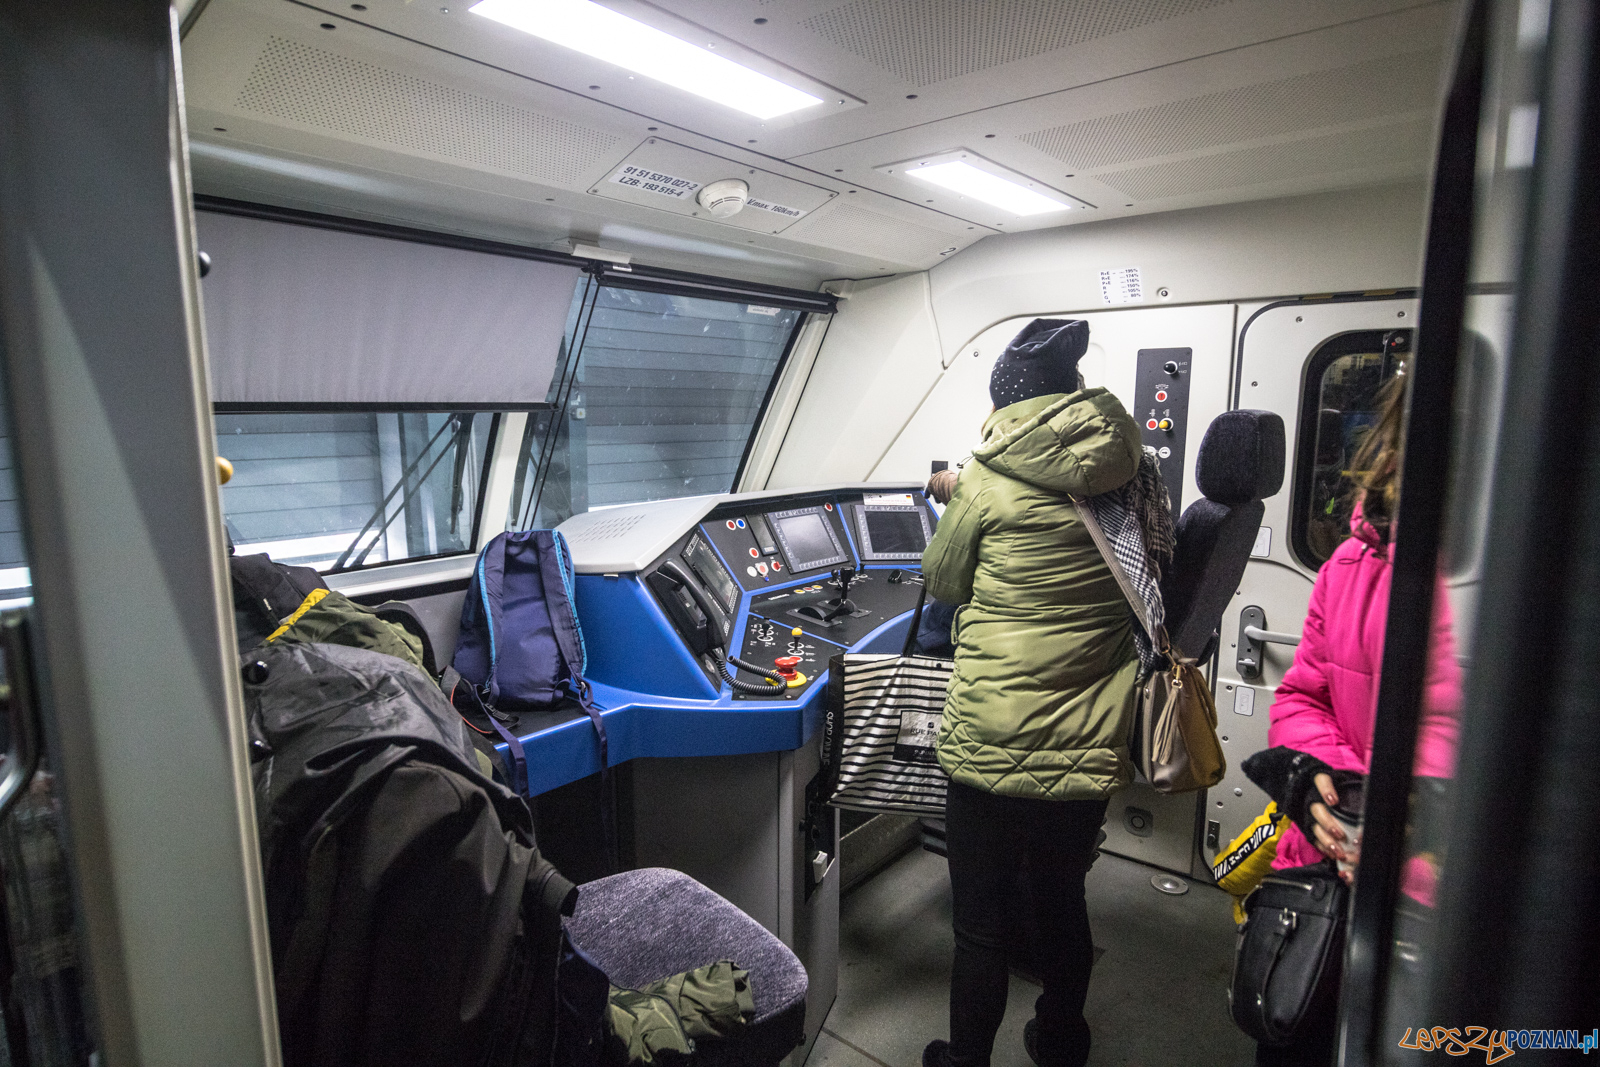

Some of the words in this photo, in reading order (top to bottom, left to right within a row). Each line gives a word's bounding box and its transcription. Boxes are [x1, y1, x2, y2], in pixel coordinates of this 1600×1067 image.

[619, 176, 641, 187] LZB:
[642, 182, 659, 191] 193
[658, 186, 684, 197] 515-4
[623, 166, 638, 175] 91
[636, 169, 650, 178] 51
[648, 173, 673, 184] 5370
[671, 179, 698, 191] 027-2
